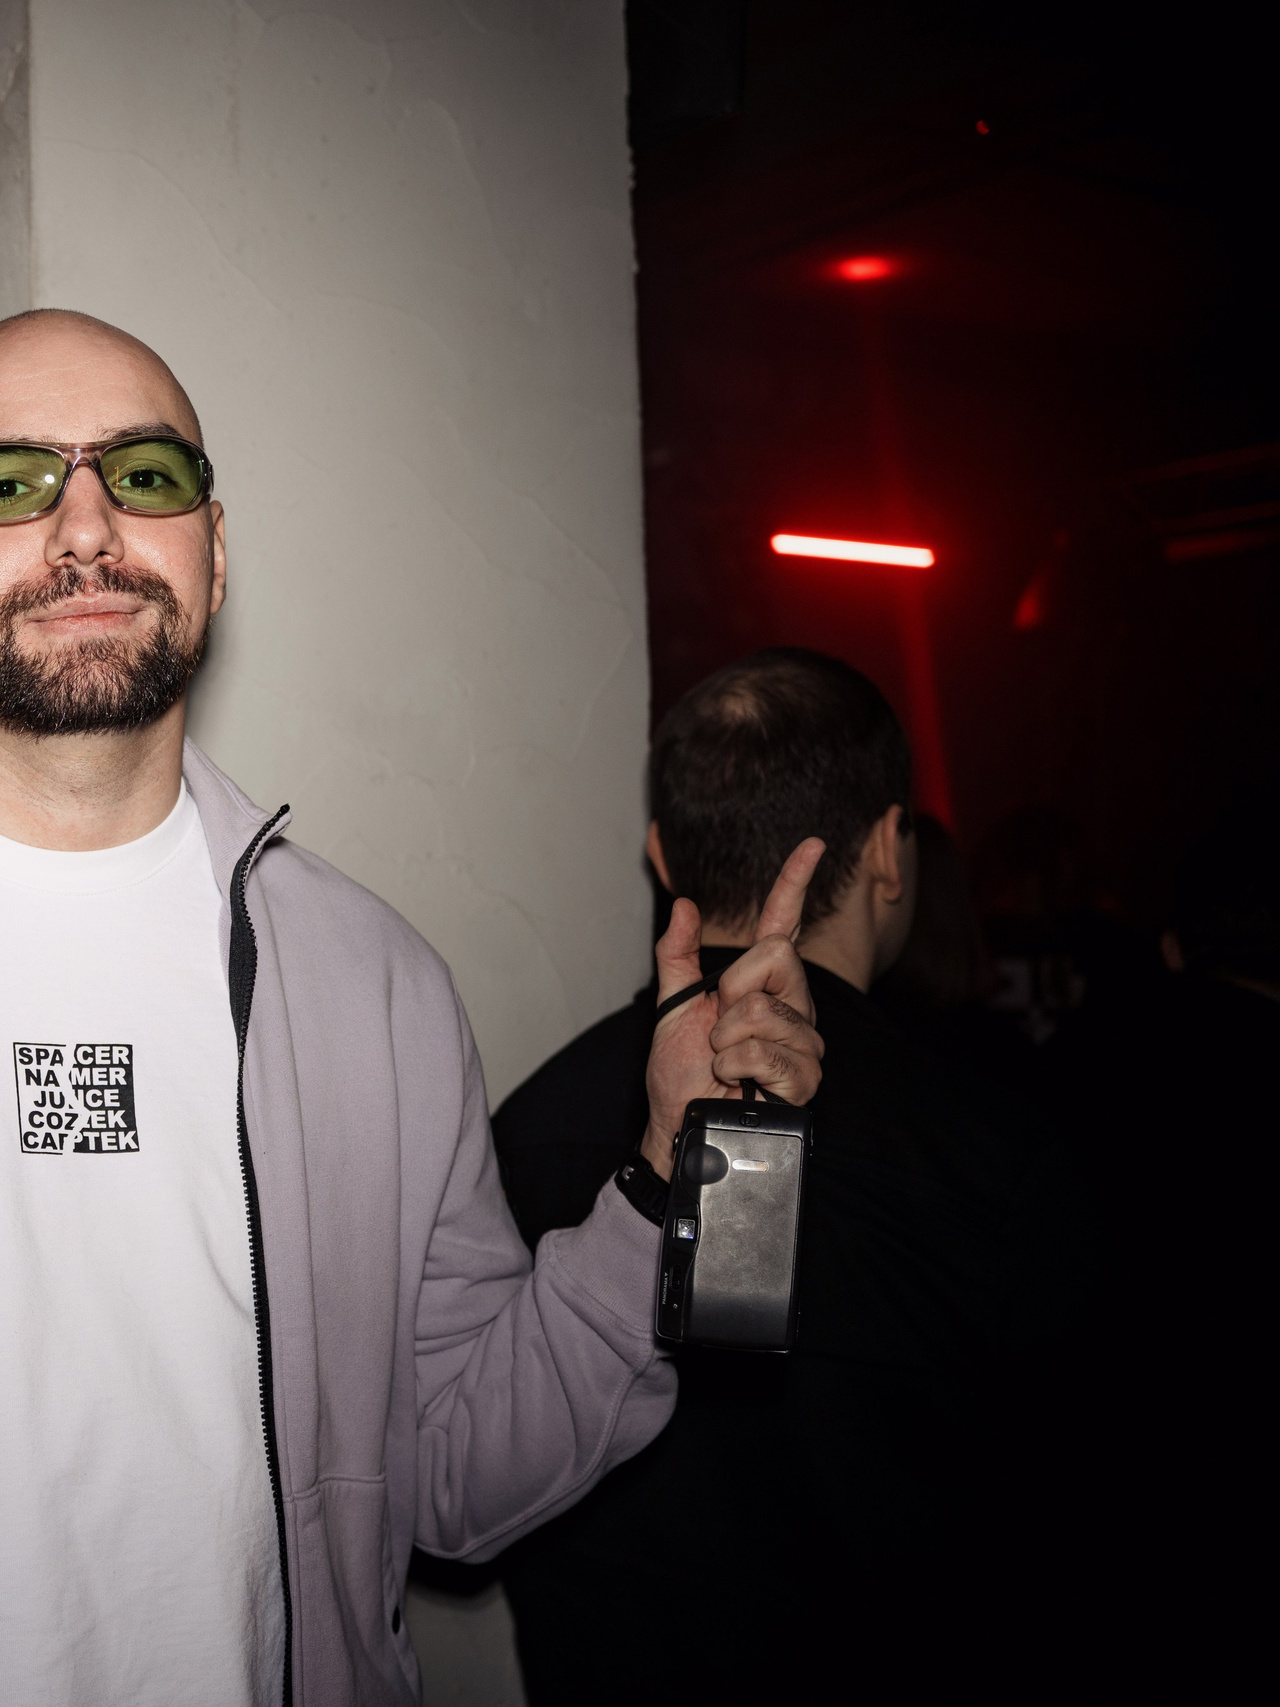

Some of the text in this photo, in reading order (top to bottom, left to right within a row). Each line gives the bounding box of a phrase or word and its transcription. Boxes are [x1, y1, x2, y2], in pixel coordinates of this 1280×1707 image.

[18, 1045, 130, 1067] SPACER
[24, 1067, 127, 1087] NAMER
[661, 1277, 669, 1305] PANORAMA
